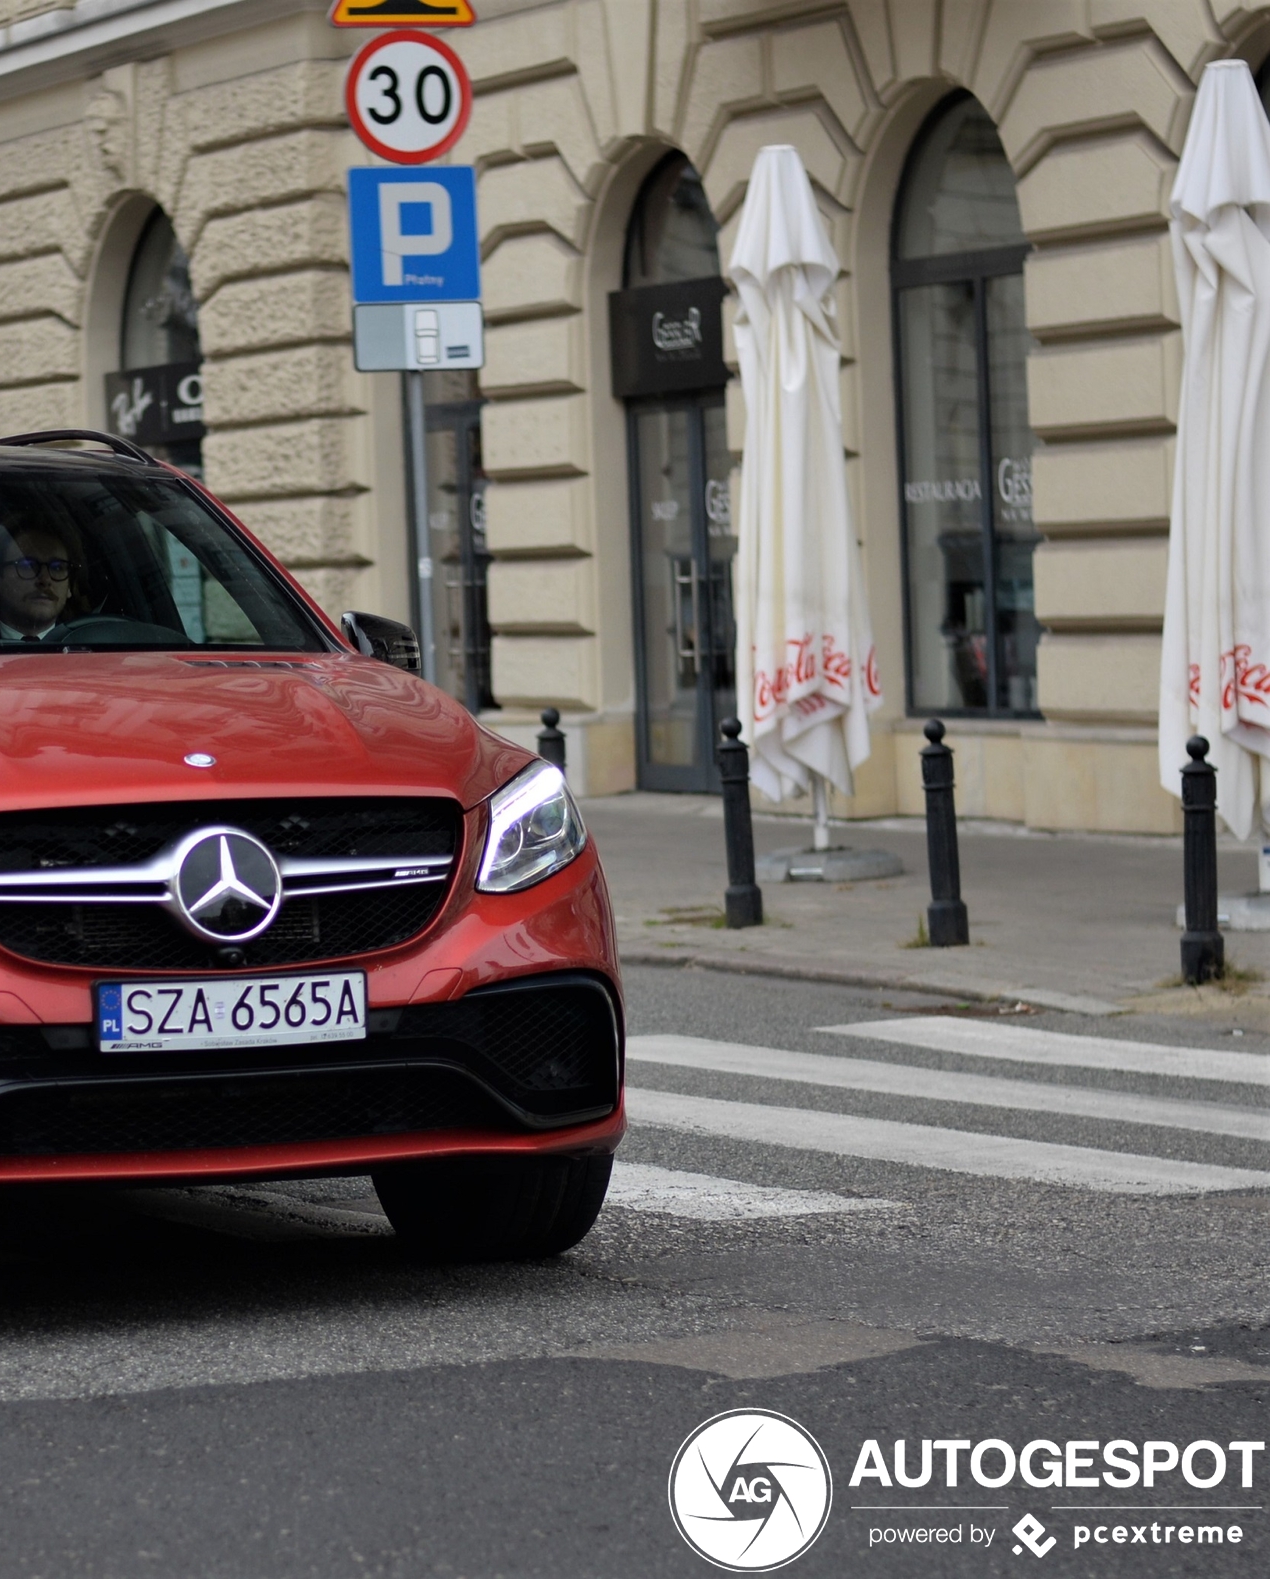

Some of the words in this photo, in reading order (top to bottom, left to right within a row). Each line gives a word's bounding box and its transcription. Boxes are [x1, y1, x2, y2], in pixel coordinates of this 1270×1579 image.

[367, 65, 452, 124] 30
[378, 182, 453, 286] P
[103, 1019, 120, 1033] PL
[126, 987, 214, 1035] SZA
[231, 979, 359, 1032] 6565A
